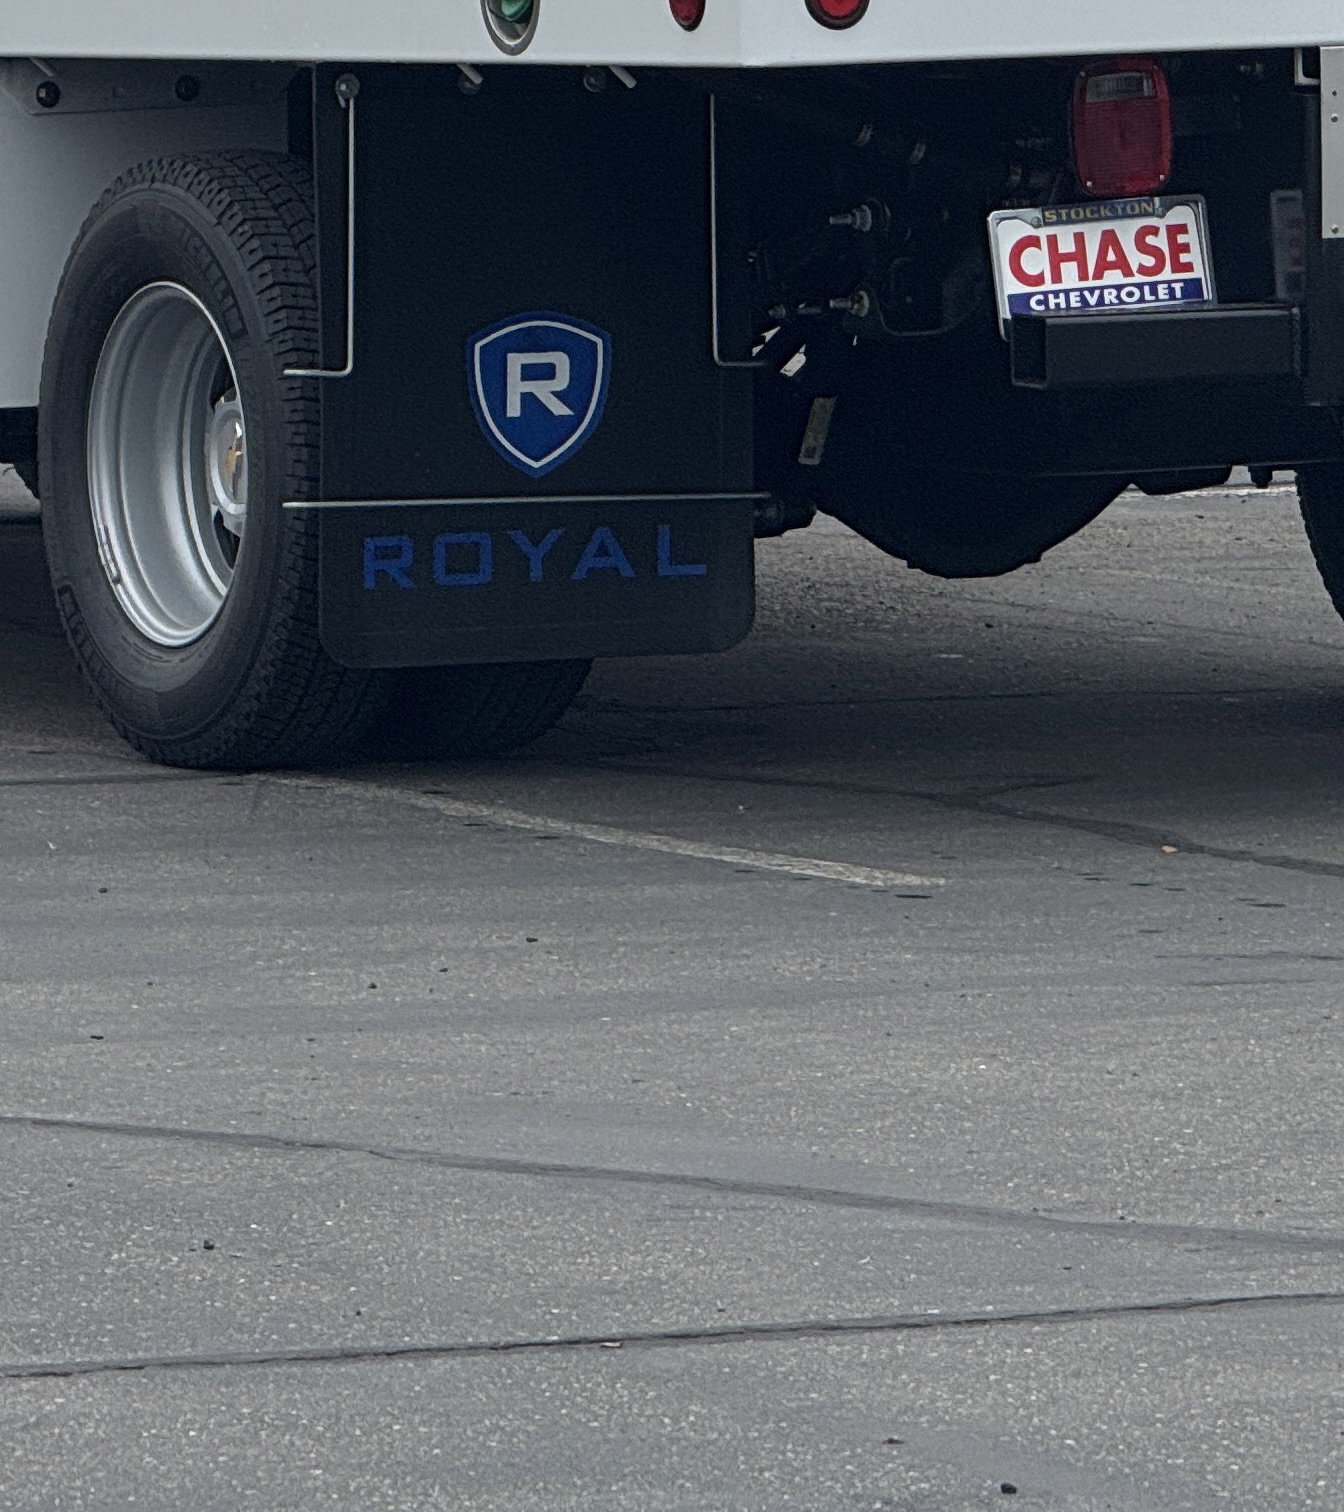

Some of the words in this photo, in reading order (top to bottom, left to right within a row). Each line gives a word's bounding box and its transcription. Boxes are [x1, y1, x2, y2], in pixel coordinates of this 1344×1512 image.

[1044, 199, 1154, 222] STOCKTON
[1008, 223, 1195, 287] CHASE
[1029, 282, 1185, 311] CHEVROLET
[506, 350, 575, 418] R
[362, 524, 708, 590] ROYAL
